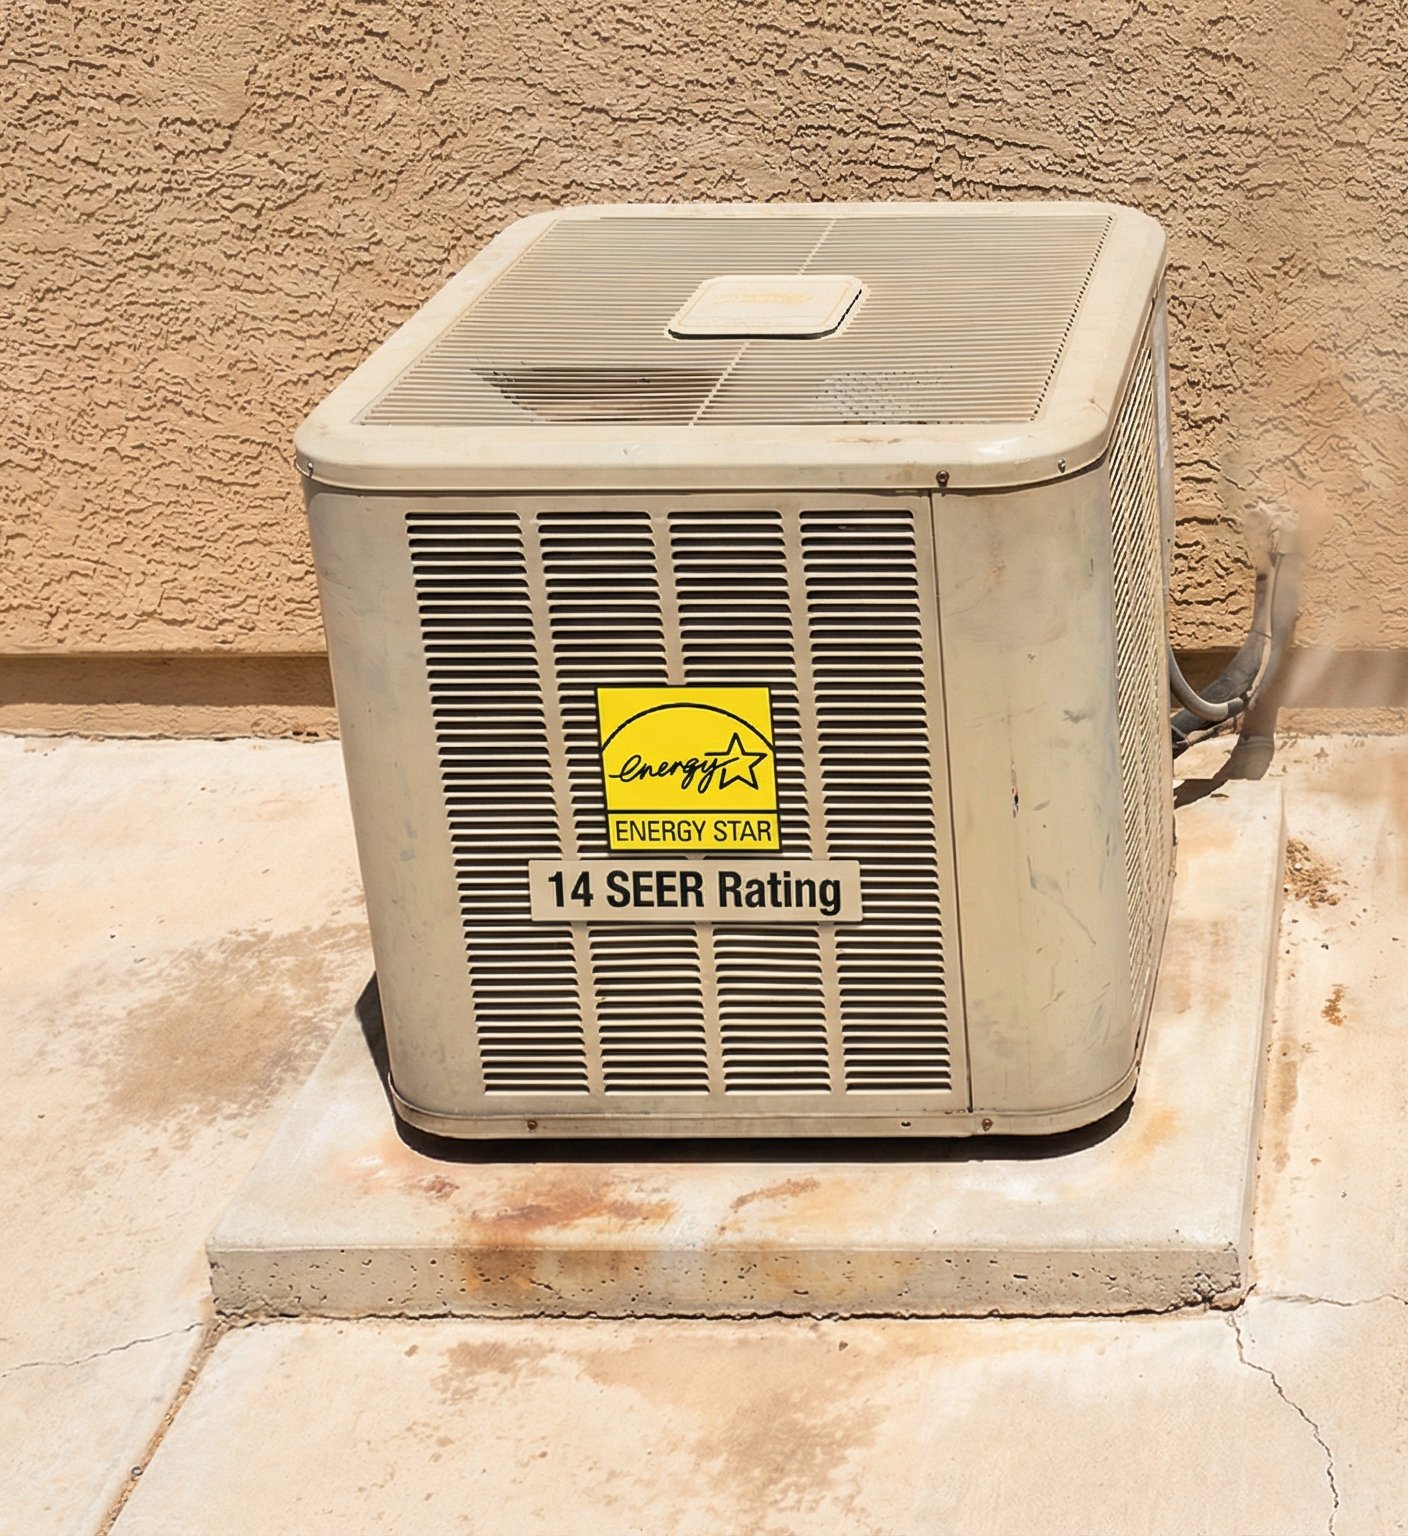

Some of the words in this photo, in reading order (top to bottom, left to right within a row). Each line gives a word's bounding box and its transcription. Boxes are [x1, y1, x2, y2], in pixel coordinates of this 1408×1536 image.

[608, 754, 739, 794] energy
[615, 820, 706, 842] ENERGY
[713, 820, 772, 842] STAR
[547, 870, 594, 908] 14
[606, 869, 705, 908] SEER
[718, 869, 841, 916] Rating
